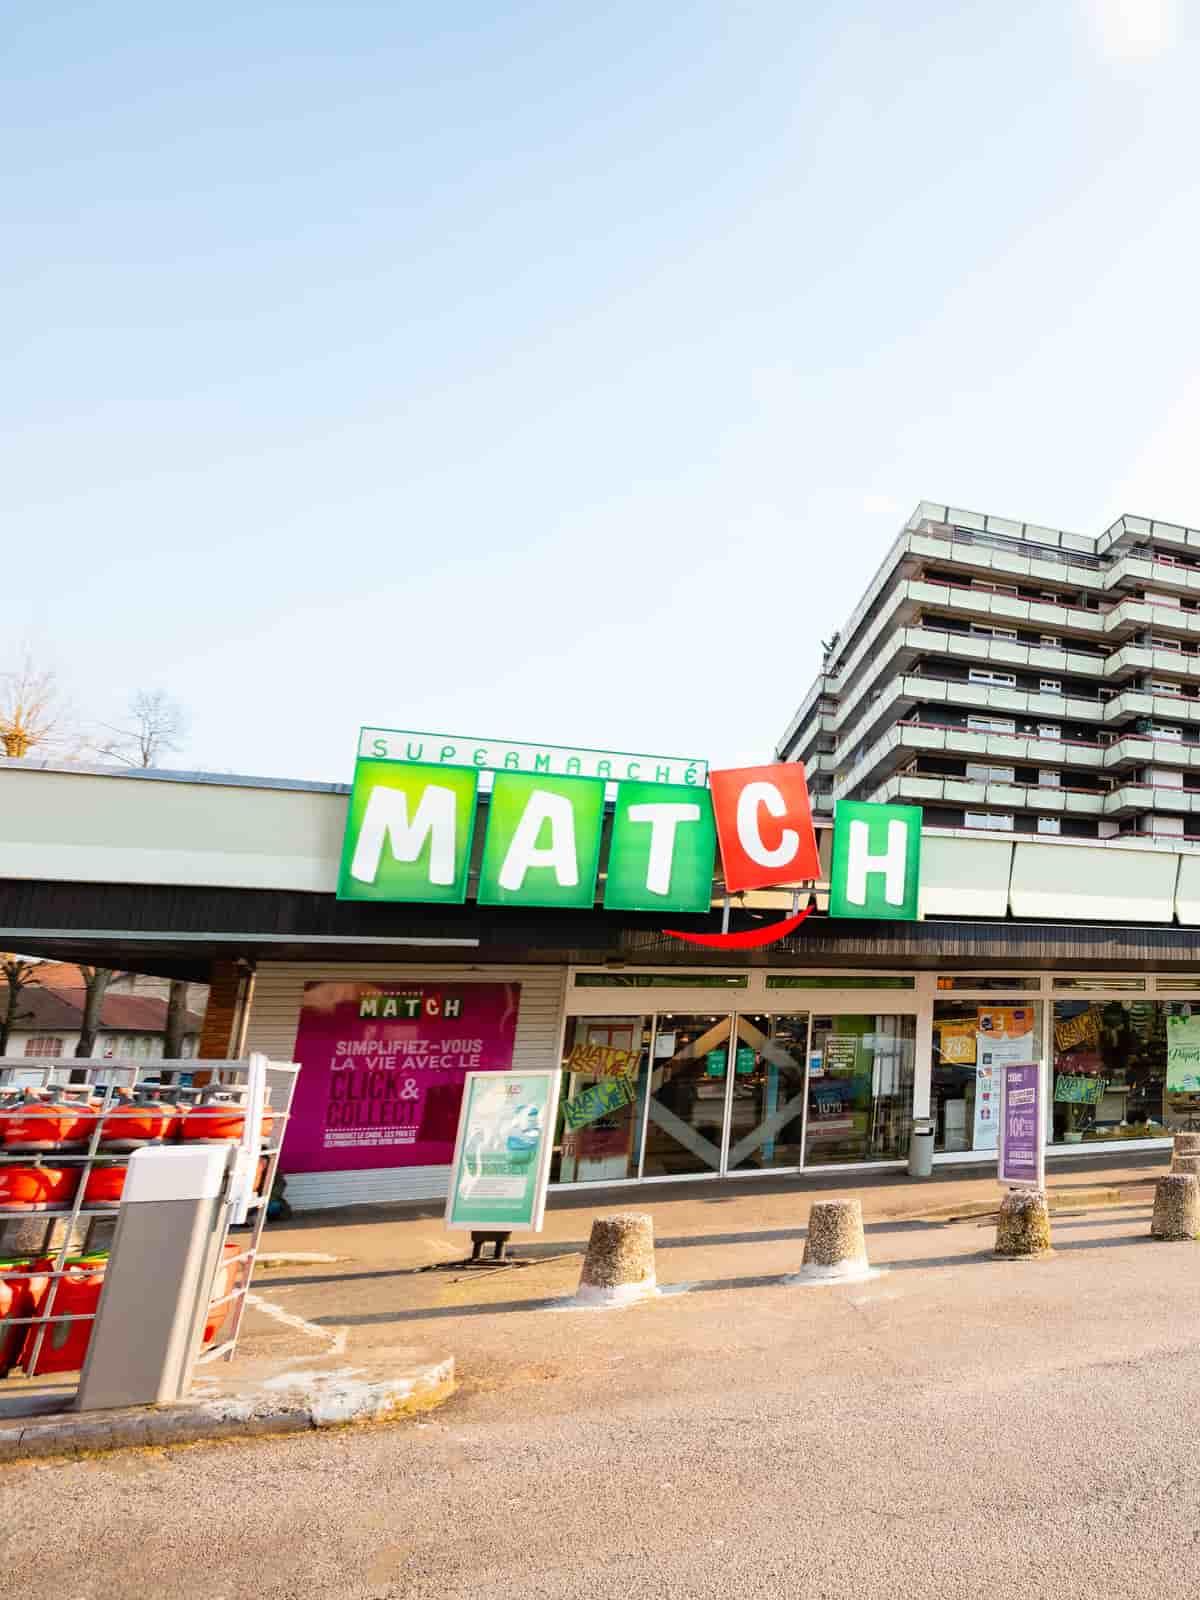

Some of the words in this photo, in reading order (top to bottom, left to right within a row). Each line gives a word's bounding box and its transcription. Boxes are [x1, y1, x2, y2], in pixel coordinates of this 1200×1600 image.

[371, 738, 698, 785] SUPERMARCHÉ
[350, 781, 908, 905] MATCH
[359, 998, 461, 1017] MATCH
[335, 1038, 483, 1056] SIMPLIFIEZ-VOUS
[330, 1056, 355, 1071] LA
[365, 1055, 397, 1071] VIE
[401, 1055, 453, 1070] AVEC
[458, 1054, 481, 1068] LE
[329, 1071, 398, 1101] CLICK
[399, 1078, 419, 1100] &
[326, 1101, 419, 1127] COLLECT
